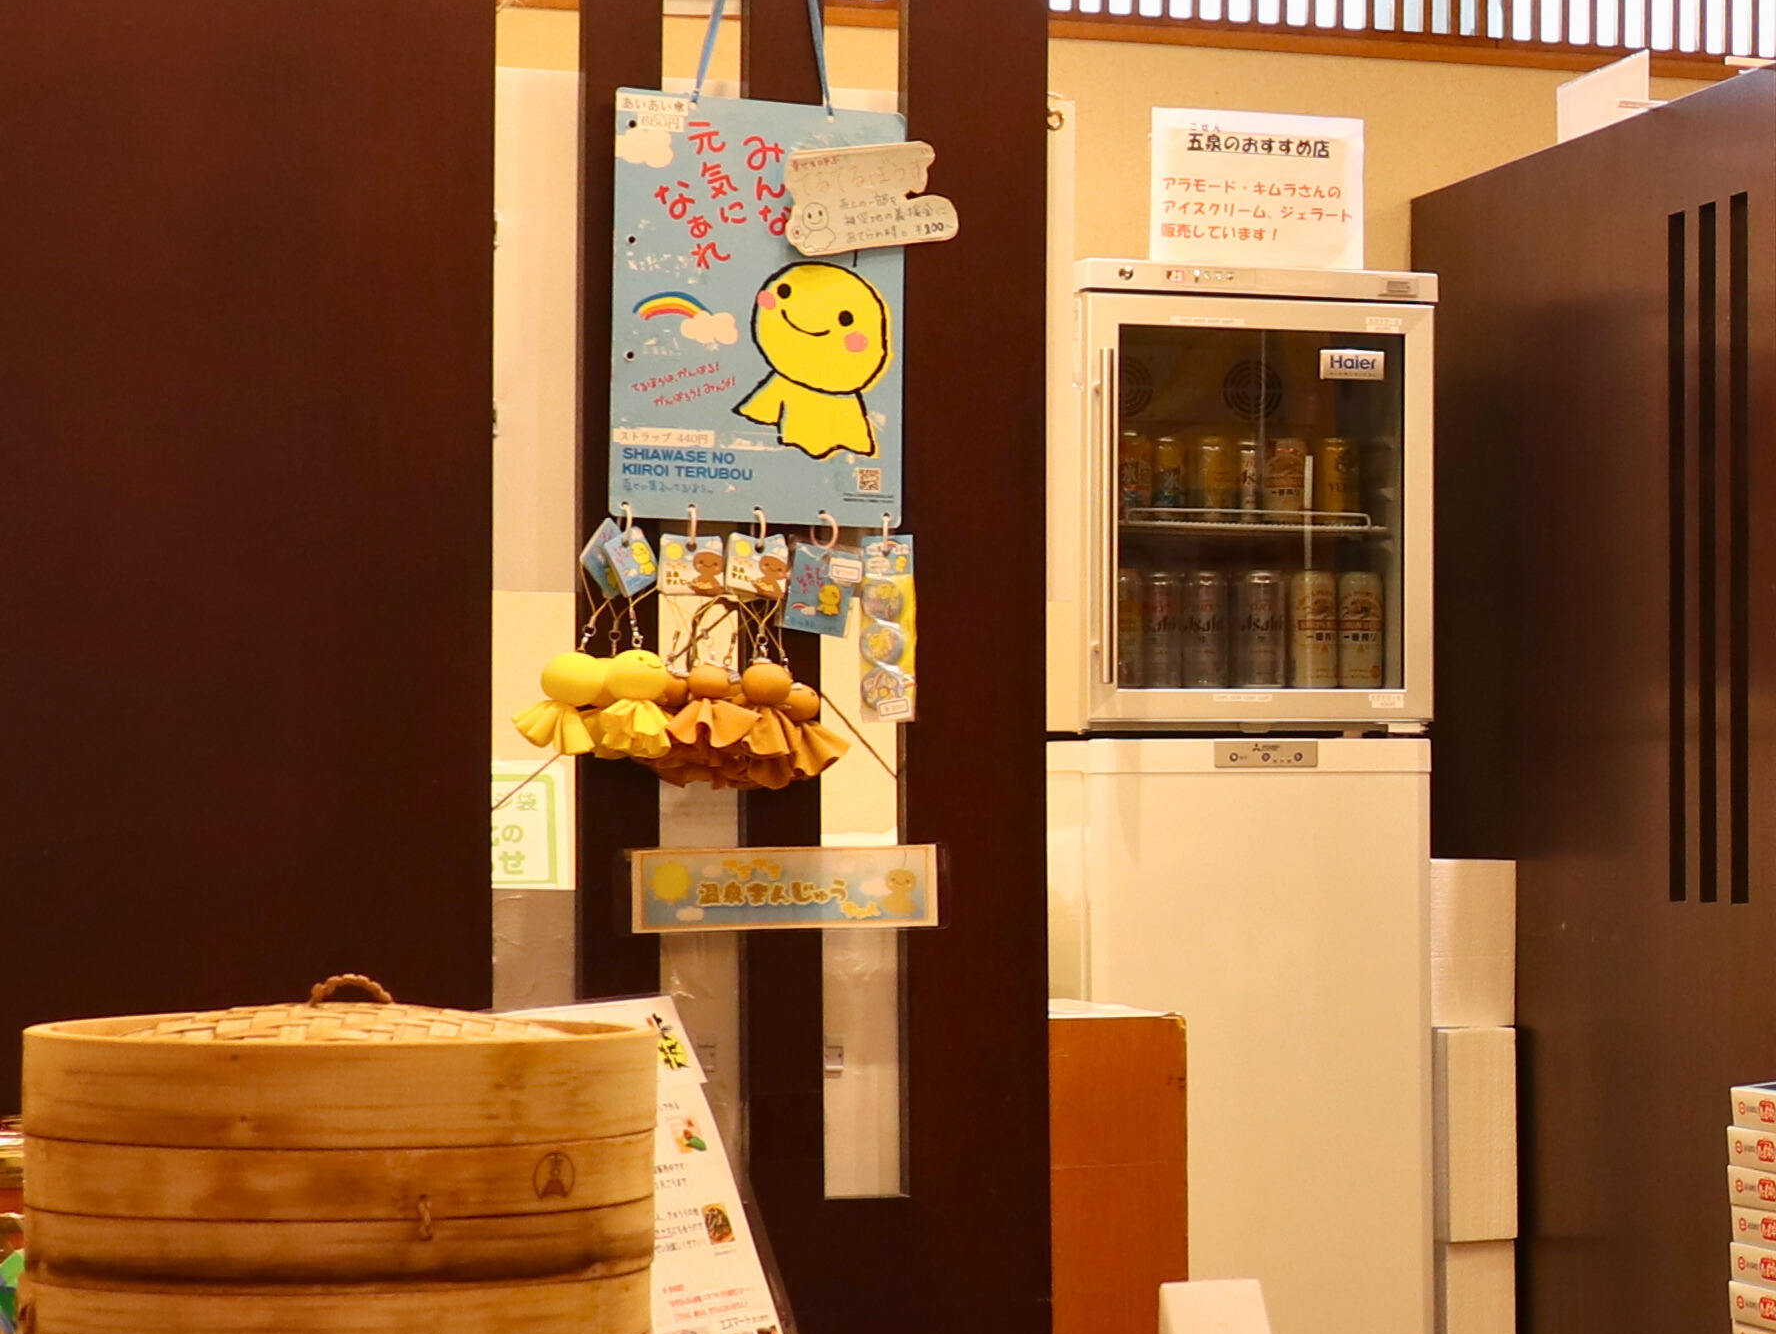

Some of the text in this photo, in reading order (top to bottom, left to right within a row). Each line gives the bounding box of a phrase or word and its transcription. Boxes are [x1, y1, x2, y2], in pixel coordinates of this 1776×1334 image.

[1186, 133, 1331, 158] 五泉のおすすめ店
[687, 121, 748, 224] 元気に
[743, 135, 792, 236] みんな
[1162, 177, 1341, 200] アラモード・キムラさんの
[1162, 200, 1353, 222] アイスクリーム、ジェラート
[1329, 355, 1376, 370] Haier
[622, 447, 736, 464] SHIAWASE NO
[622, 463, 754, 481] KIIROI TERUBOU
[698, 879, 849, 907] 温泉まんじゅう
